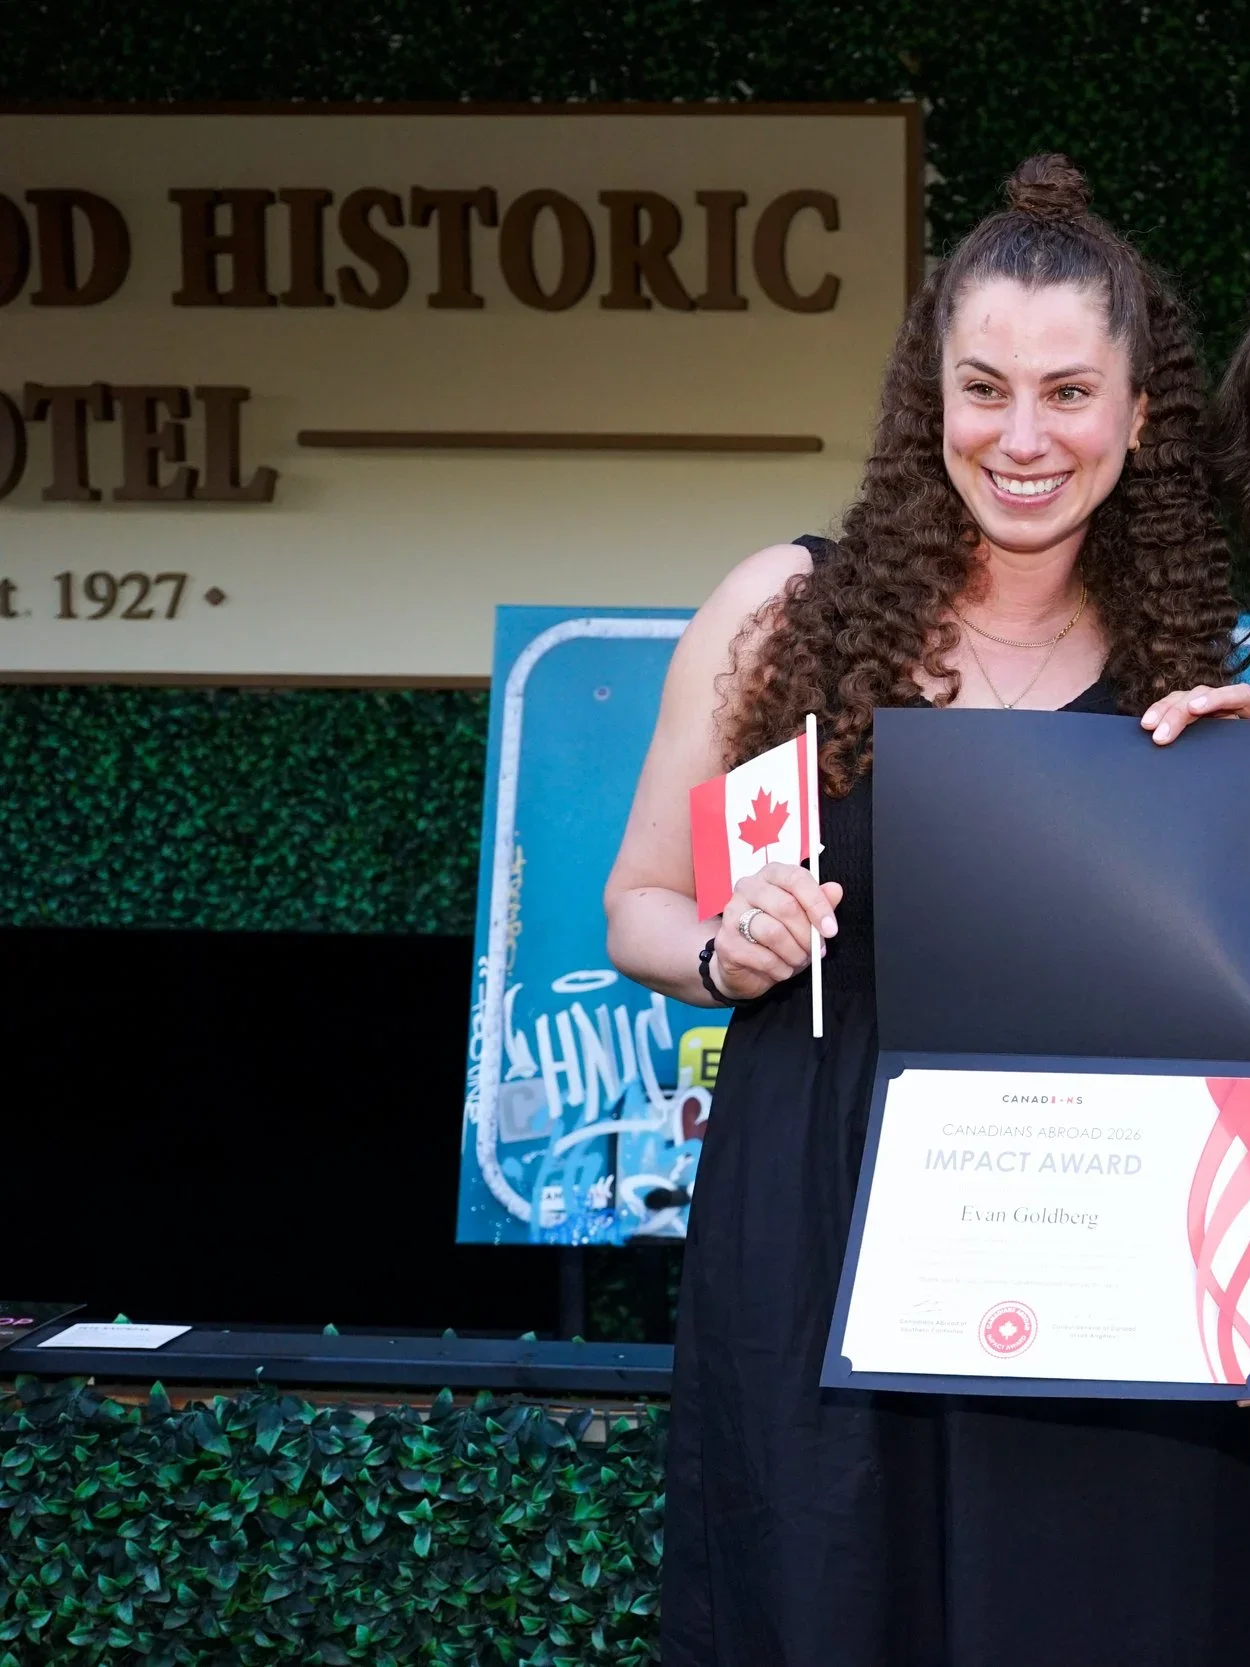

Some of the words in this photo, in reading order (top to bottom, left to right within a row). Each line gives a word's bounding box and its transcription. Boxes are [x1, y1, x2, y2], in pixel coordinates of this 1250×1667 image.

[169, 186, 841, 313] HISTORIC
[0, 382, 278, 503] TEL
[54, 570, 188, 620] 1927
[942, 1123, 1033, 1138] CANADIANS
[1037, 1126, 1102, 1140] ABROAD
[1107, 1127, 1142, 1141] 2026
[924, 1149, 1031, 1173] IMPACT
[1038, 1152, 1143, 1176] AWARD
[961, 1205, 1006, 1223] Evan
[1013, 1206, 1099, 1230] Goldberg
